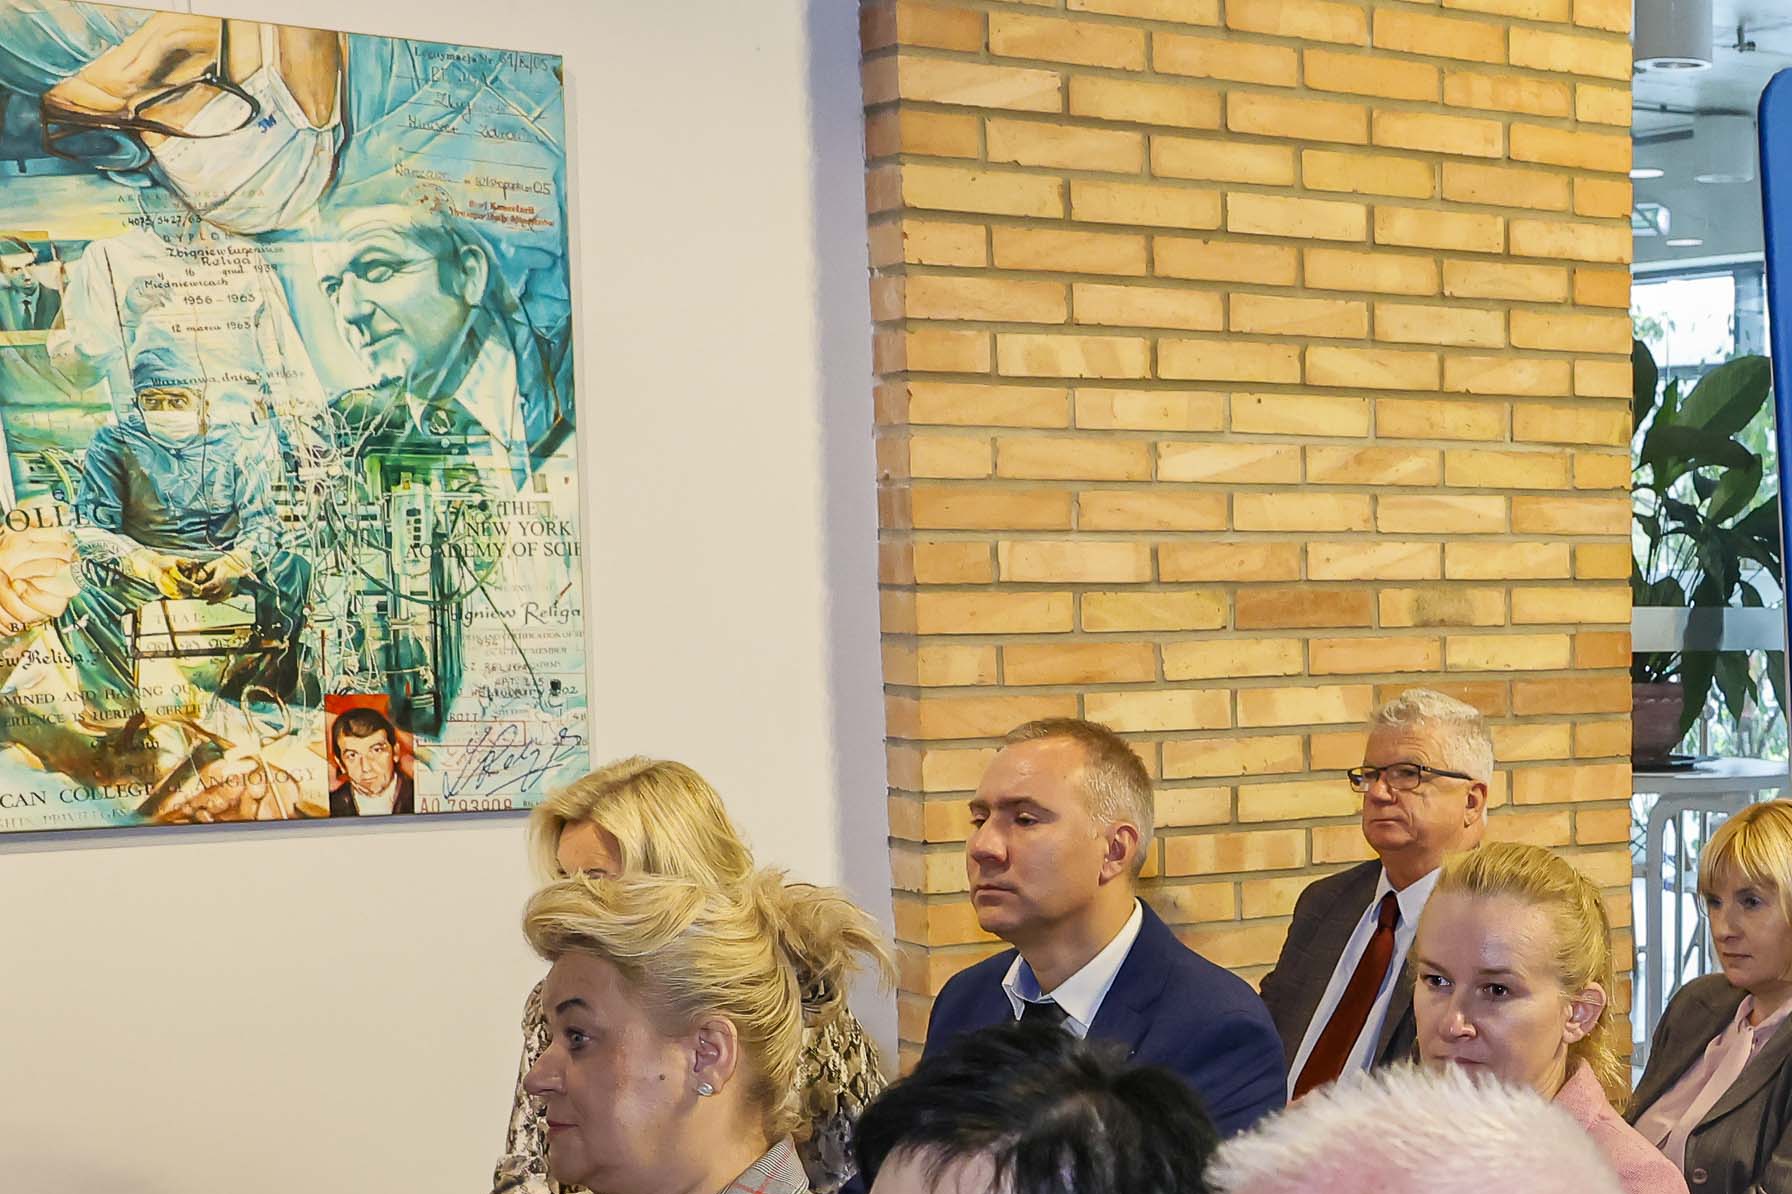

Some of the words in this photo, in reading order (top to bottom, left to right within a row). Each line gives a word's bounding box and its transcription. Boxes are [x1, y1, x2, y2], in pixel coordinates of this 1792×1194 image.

[502, 500, 536, 516] THE
[466, 521, 511, 536] NEW
[519, 520, 571, 537] YORK
[512, 543, 538, 557] OF
